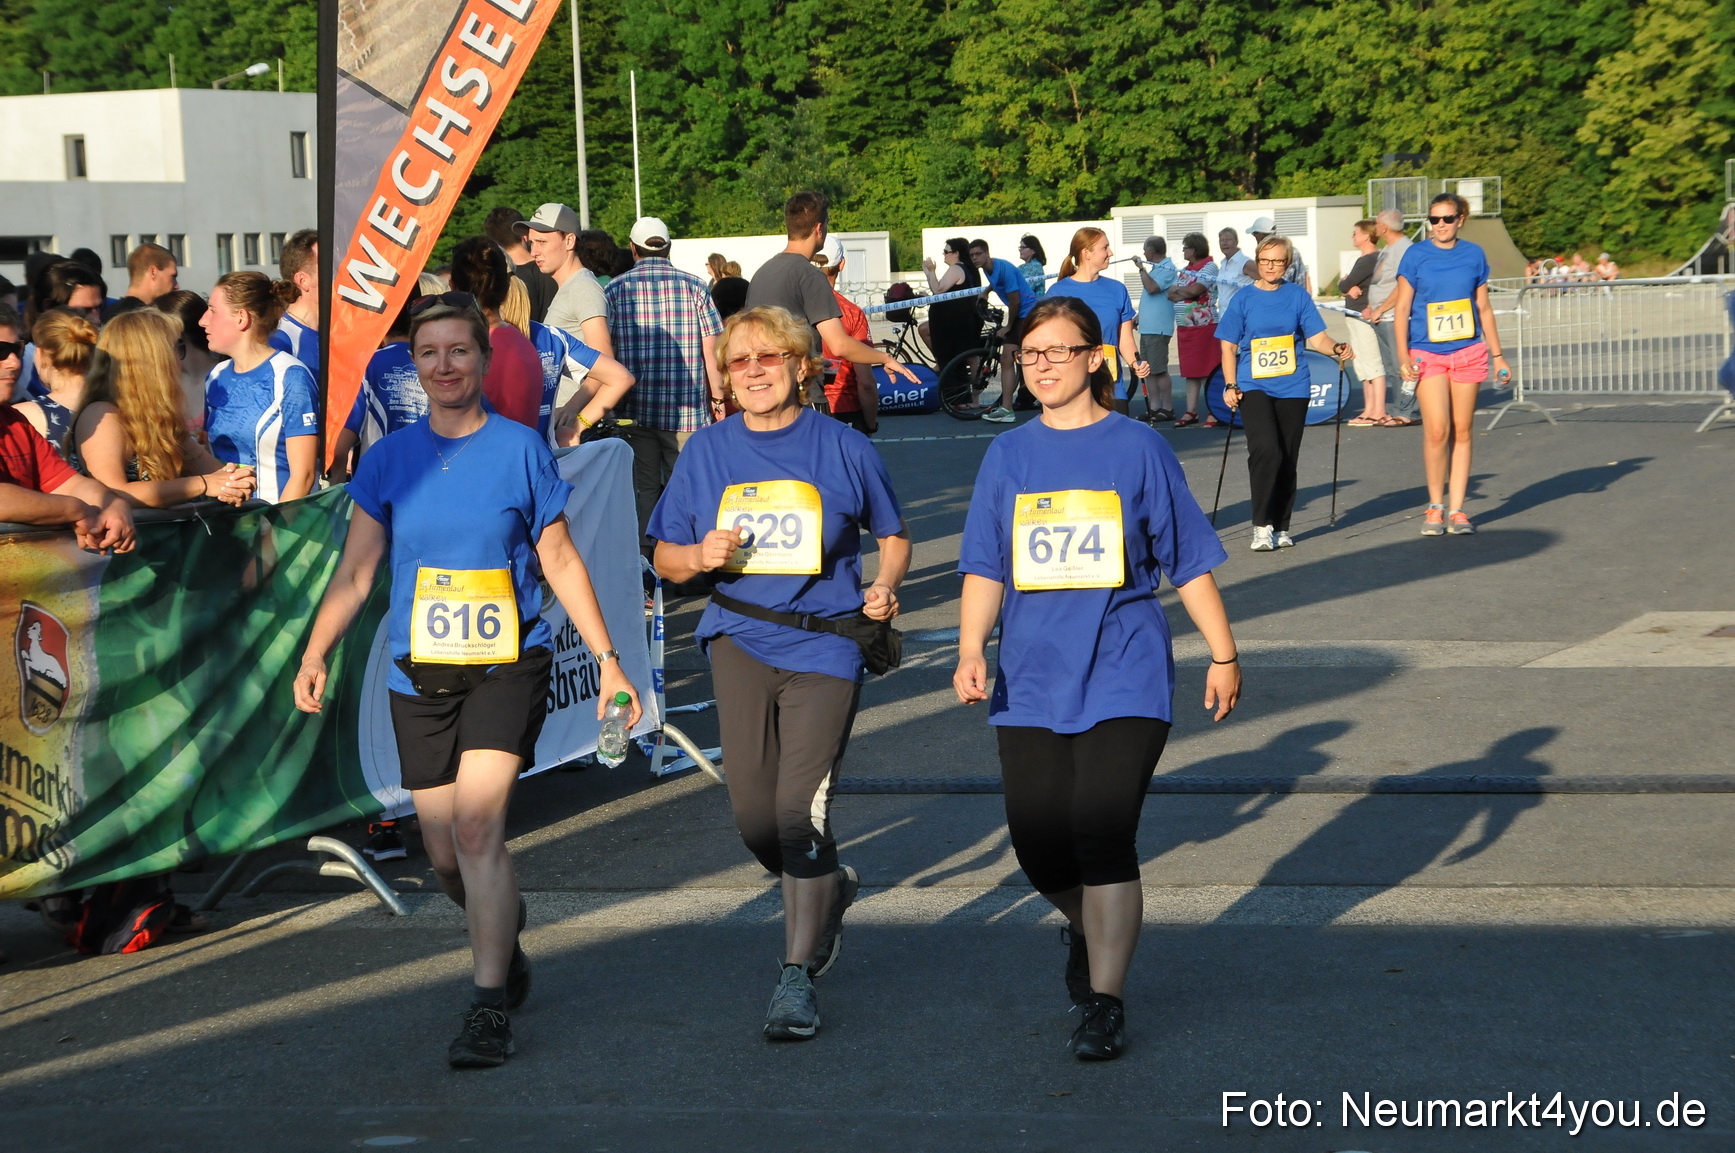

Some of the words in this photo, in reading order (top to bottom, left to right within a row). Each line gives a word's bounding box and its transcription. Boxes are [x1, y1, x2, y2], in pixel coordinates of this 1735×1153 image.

[1435, 313, 1463, 331] 711
[1259, 349, 1288, 367] 625
[878, 387, 928, 406] cher
[1029, 507, 1064, 516] firmenlauf
[733, 513, 803, 549] 629
[1028, 524, 1105, 564] 674
[428, 584, 465, 593] firmenlauf
[426, 602, 501, 640] 616
